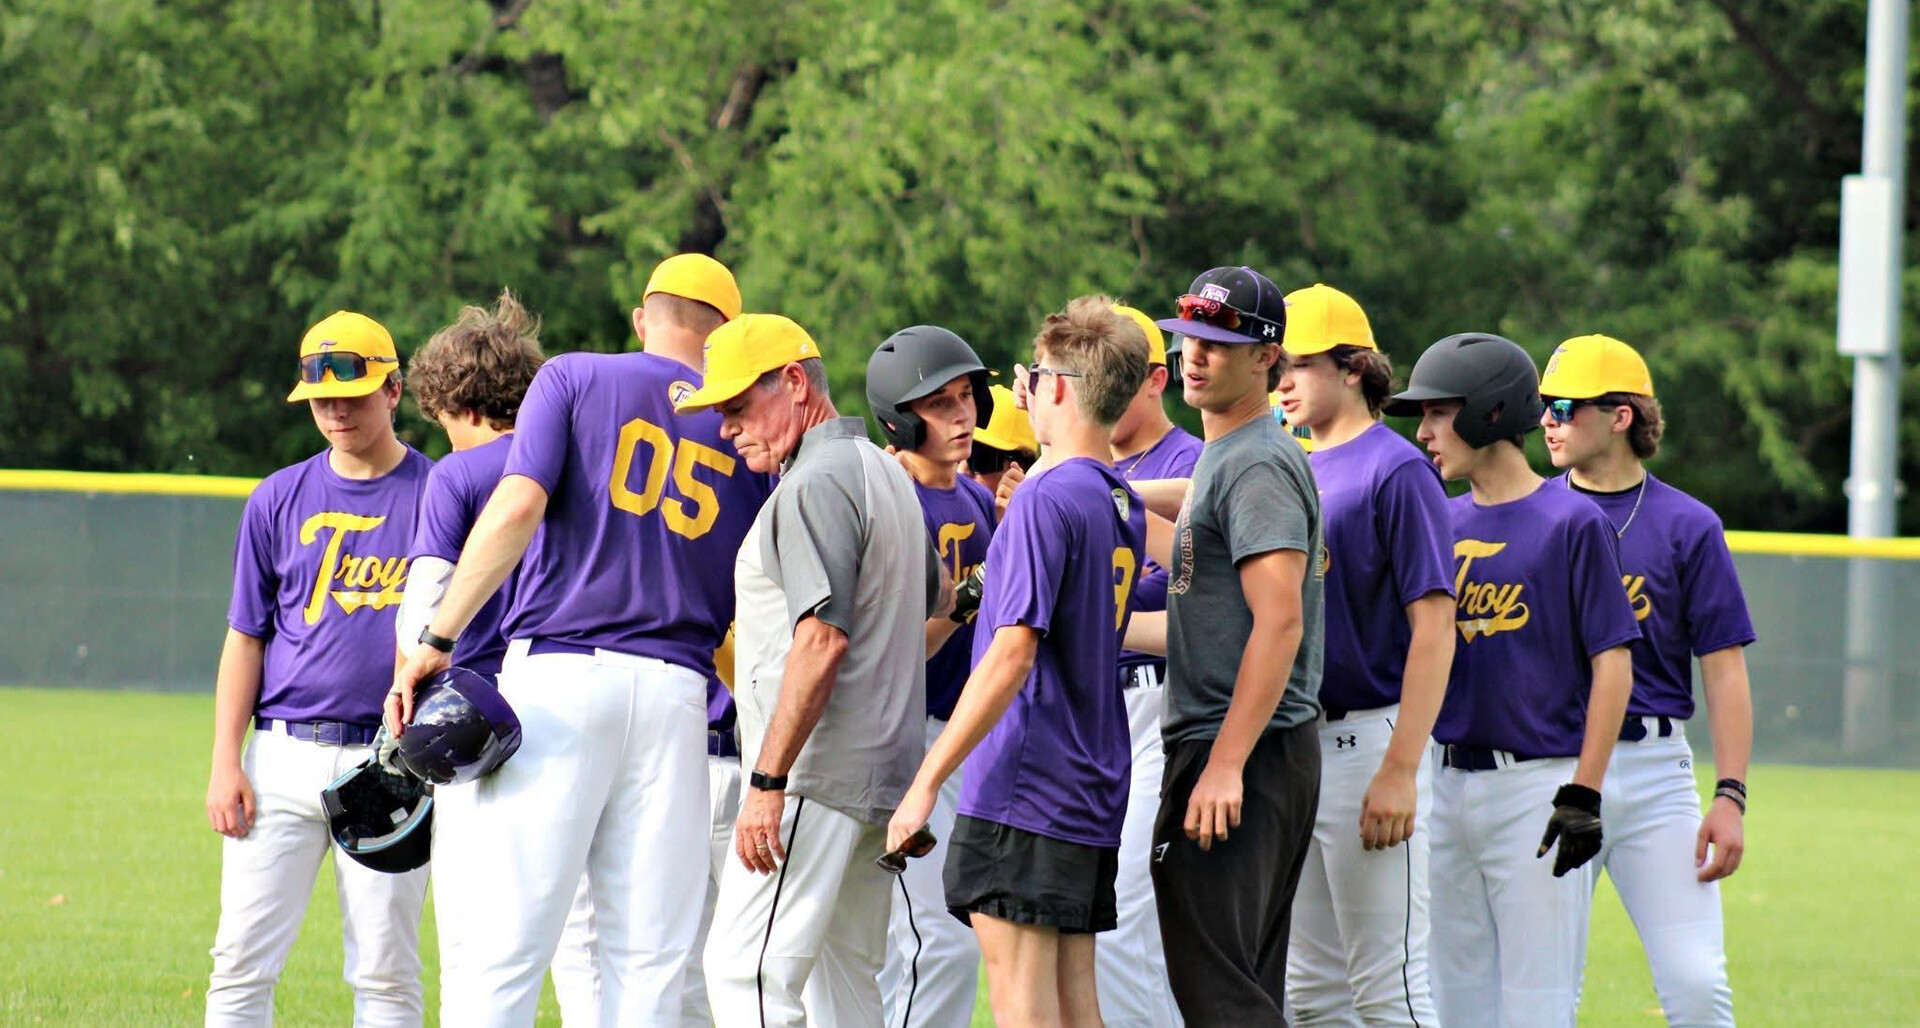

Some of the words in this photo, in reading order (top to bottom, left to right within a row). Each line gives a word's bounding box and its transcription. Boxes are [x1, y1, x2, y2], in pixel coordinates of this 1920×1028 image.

[609, 417, 736, 540] 05
[299, 511, 407, 625] Troy
[1175, 528, 1194, 595] TROJANS
[1454, 539, 1529, 638] Troy
